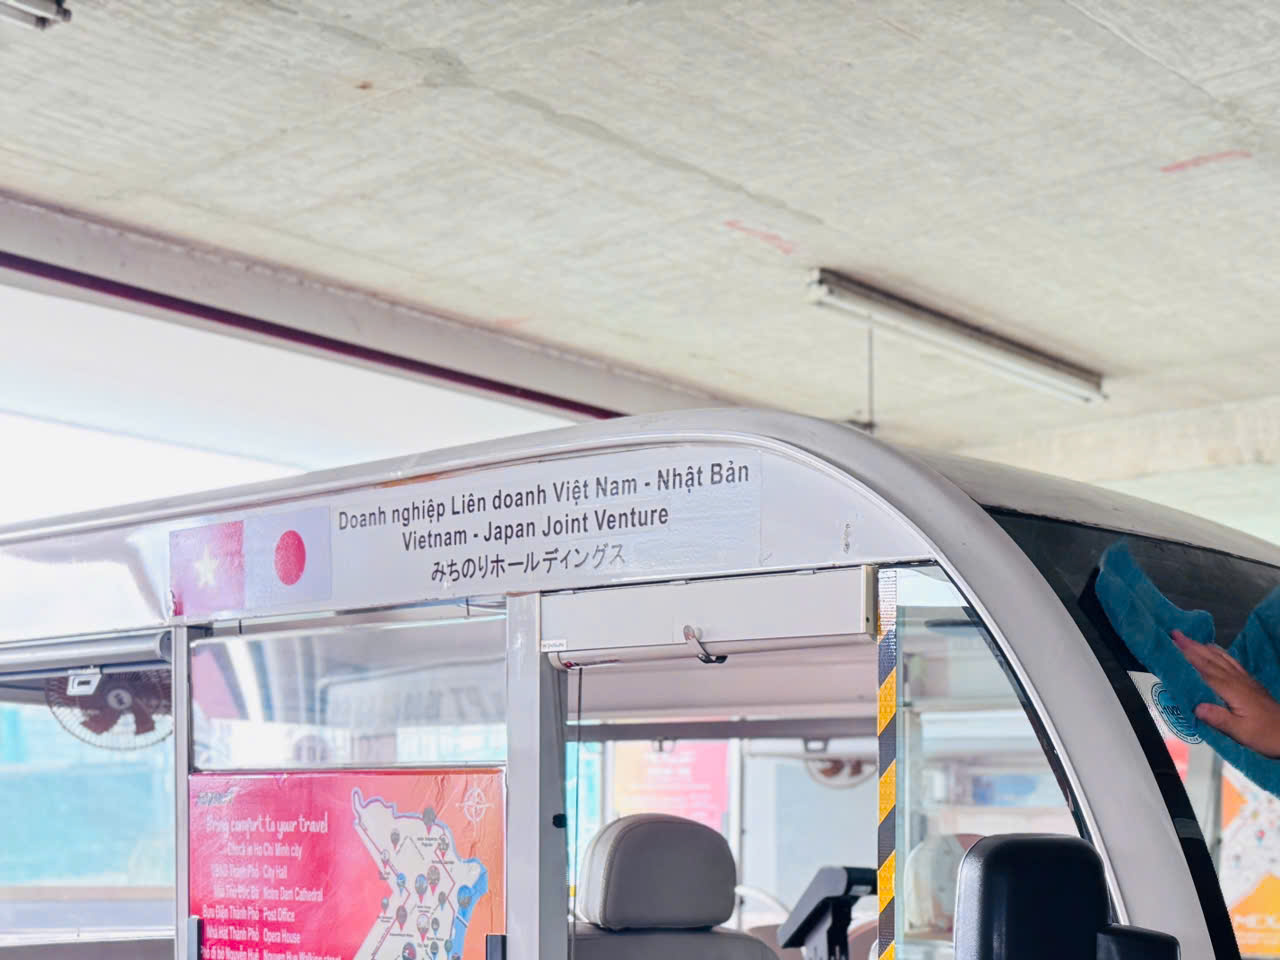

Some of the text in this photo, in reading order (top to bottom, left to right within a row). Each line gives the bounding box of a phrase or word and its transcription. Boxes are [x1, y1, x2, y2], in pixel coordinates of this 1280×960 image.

[339, 506, 387, 530] Doanh
[392, 498, 446, 527] nghiệp
[451, 493, 487, 516] Liên
[492, 484, 547, 510] doanh
[553, 478, 589, 506] Việt
[596, 475, 638, 499] Nam
[657, 464, 704, 493] Nhật
[711, 460, 750, 485] Bản
[402, 528, 467, 551] Vietnam
[484, 520, 536, 544] Japan
[542, 511, 588, 537] Joint
[594, 506, 669, 531] Venture
[431, 543, 626, 582] みちのりホールディングス
[231, 815, 264, 839] comfort
[265, 814, 276, 832] to
[277, 820, 298, 840] your
[299, 811, 329, 833] travel
[263, 907, 276, 921] Post
[277, 907, 295, 922] Office
[263, 928, 281, 944] Opera
[281, 929, 300, 944] House
